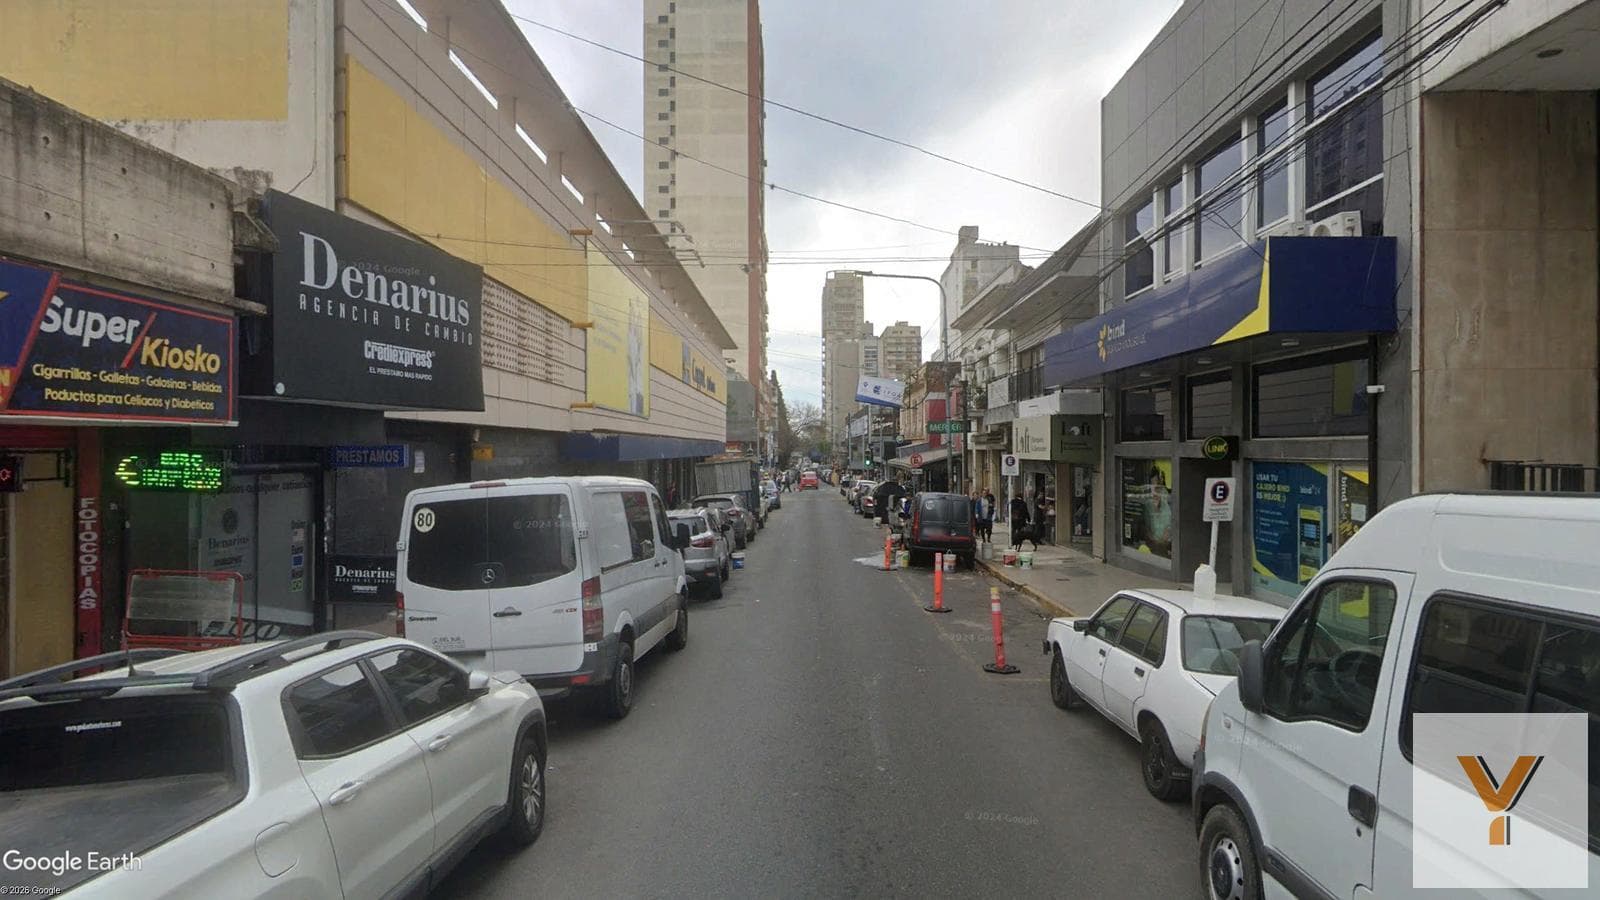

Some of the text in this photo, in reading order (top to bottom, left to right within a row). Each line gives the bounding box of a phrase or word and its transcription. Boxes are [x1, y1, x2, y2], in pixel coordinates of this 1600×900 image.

[299, 232, 470, 326] Denarius
[40, 296, 140, 347] Super
[300, 294, 472, 345] AGENCIA DE CAMBIO
[141, 336, 220, 373] Kiosko
[100, 370, 139, 386] Galletas
[146, 376, 187, 389] Golosinas
[192, 381, 222, 393] Bebidas
[377, 368, 403, 378] PRESTAMO
[416, 373, 432, 381] RAPIDO
[97, 394, 122, 406] para
[165, 398, 170, 410] y
[336, 450, 399, 464] PRESTAMOS
[1216, 485, 1224, 499] E
[417, 512, 432, 527] 80
[79, 498, 98, 609] FOTOCOPIAS
[335, 565, 396, 578] Denarius
